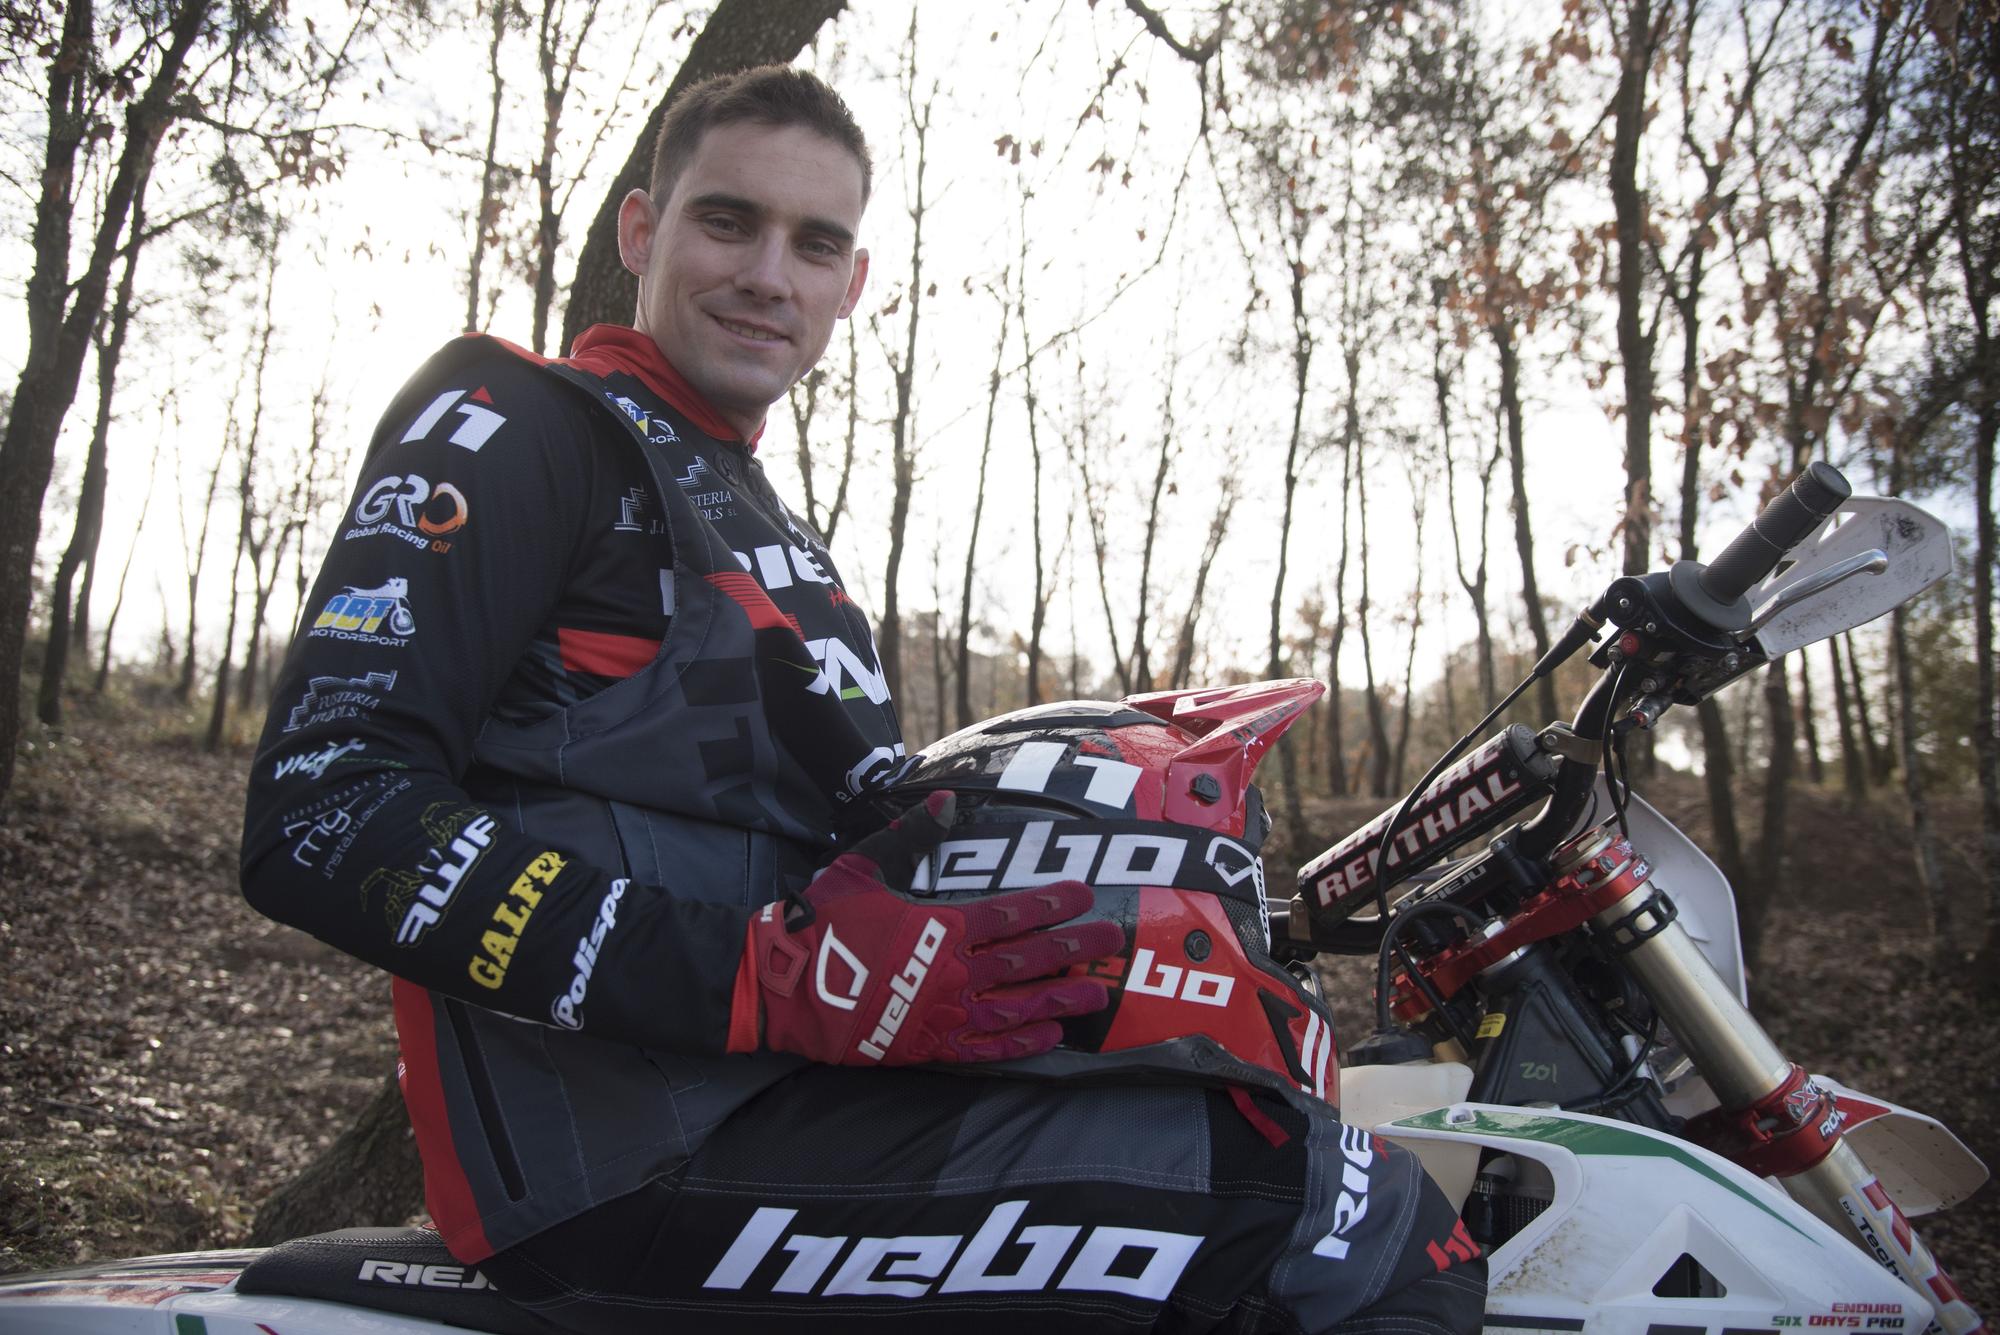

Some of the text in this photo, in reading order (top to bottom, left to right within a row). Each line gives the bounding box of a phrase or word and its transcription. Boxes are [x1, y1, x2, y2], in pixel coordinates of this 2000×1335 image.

[355, 474, 468, 536] GRO
[344, 522, 452, 554] Global Racing Oil
[308, 628, 409, 648] MOTORSPORT
[1315, 770, 1521, 907] RENTHAL
[467, 851, 569, 990] GALFER
[856, 917, 947, 1062] hebo
[702, 1200, 1206, 1301] hebo
[358, 1259, 498, 1291] RIEJ
[1771, 1315, 1803, 1328] SIX
[1808, 1315, 1861, 1328] DAYS
[1866, 1316, 1905, 1329] PRO
[1831, 1301, 1902, 1315] ENDURO
